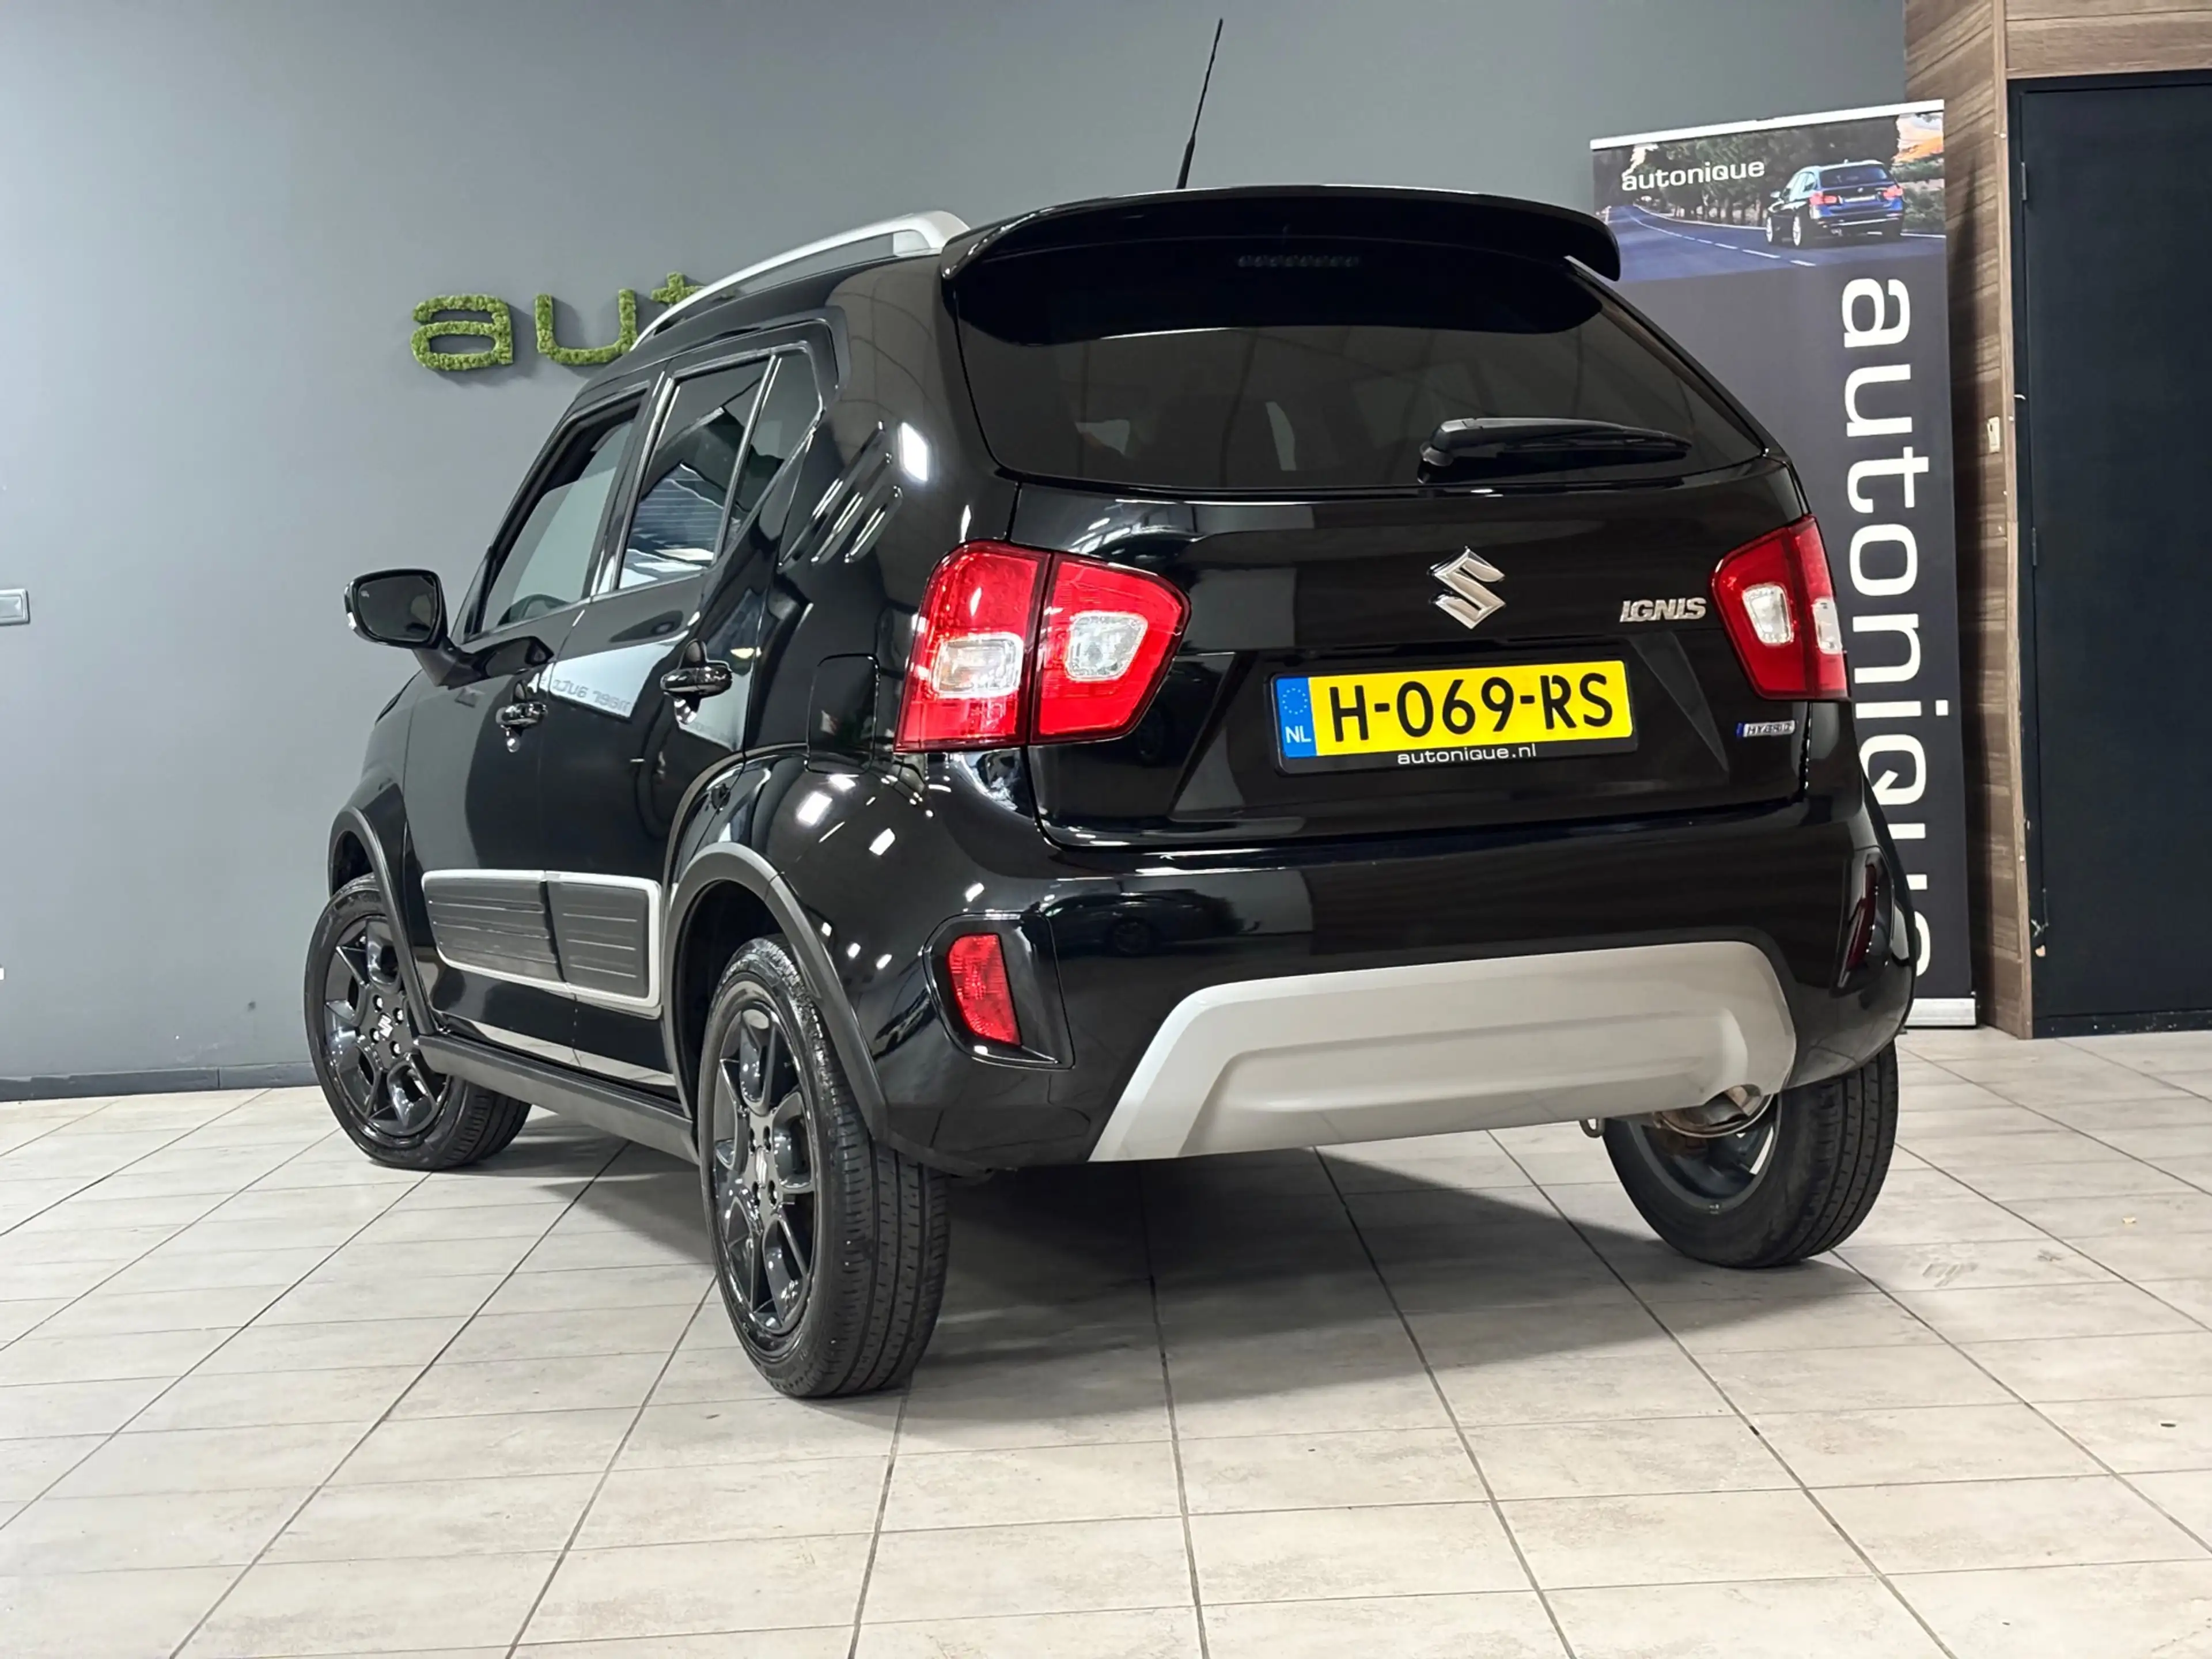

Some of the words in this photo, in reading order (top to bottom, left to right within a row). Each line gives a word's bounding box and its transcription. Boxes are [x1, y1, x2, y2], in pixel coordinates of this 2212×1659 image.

[1621, 160, 1765, 192] autonique
[1619, 597, 1707, 623] IGNIS
[1842, 277, 1949, 978] autoniq
[1285, 724, 1312, 744] NL
[1328, 672, 1613, 743] H-069-RS
[1397, 743, 1537, 766] autonique.nl
